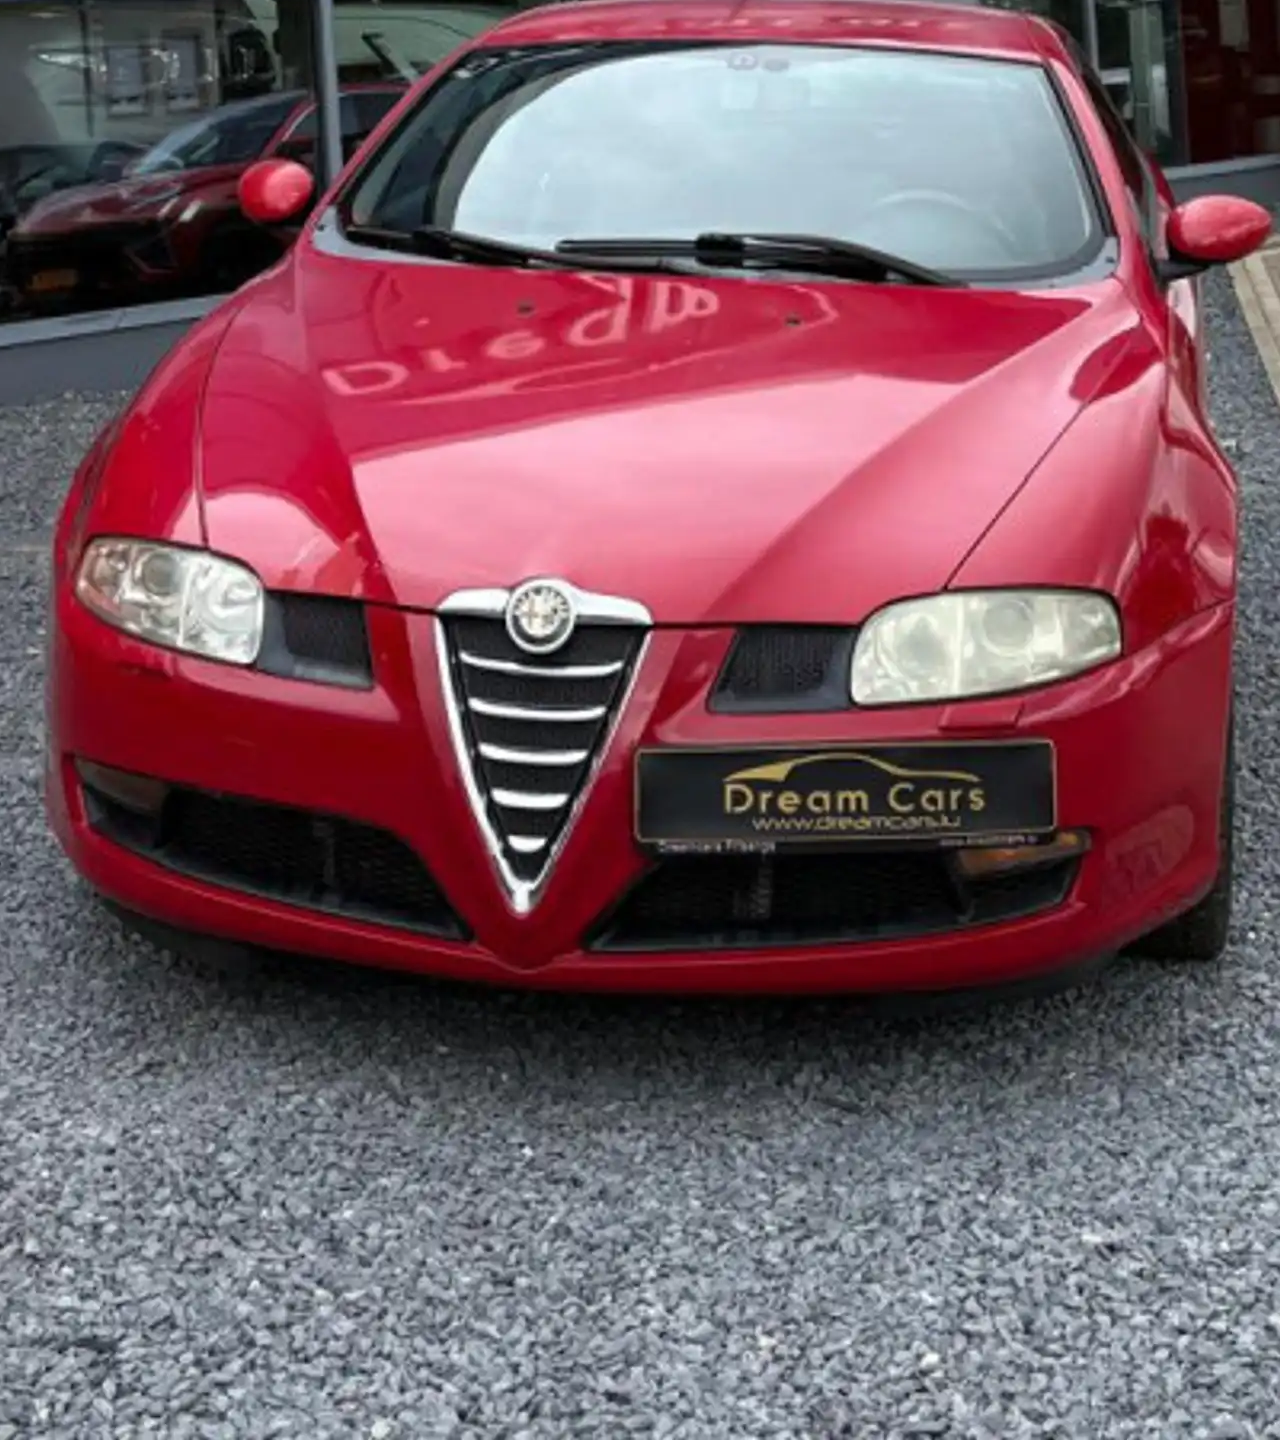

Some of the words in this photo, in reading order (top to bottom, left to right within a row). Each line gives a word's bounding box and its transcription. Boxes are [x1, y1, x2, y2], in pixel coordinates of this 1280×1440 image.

[724, 783, 870, 814] Dream
[887, 782, 986, 813] Cars
[752, 814, 961, 832] www.dreamcars.lu
